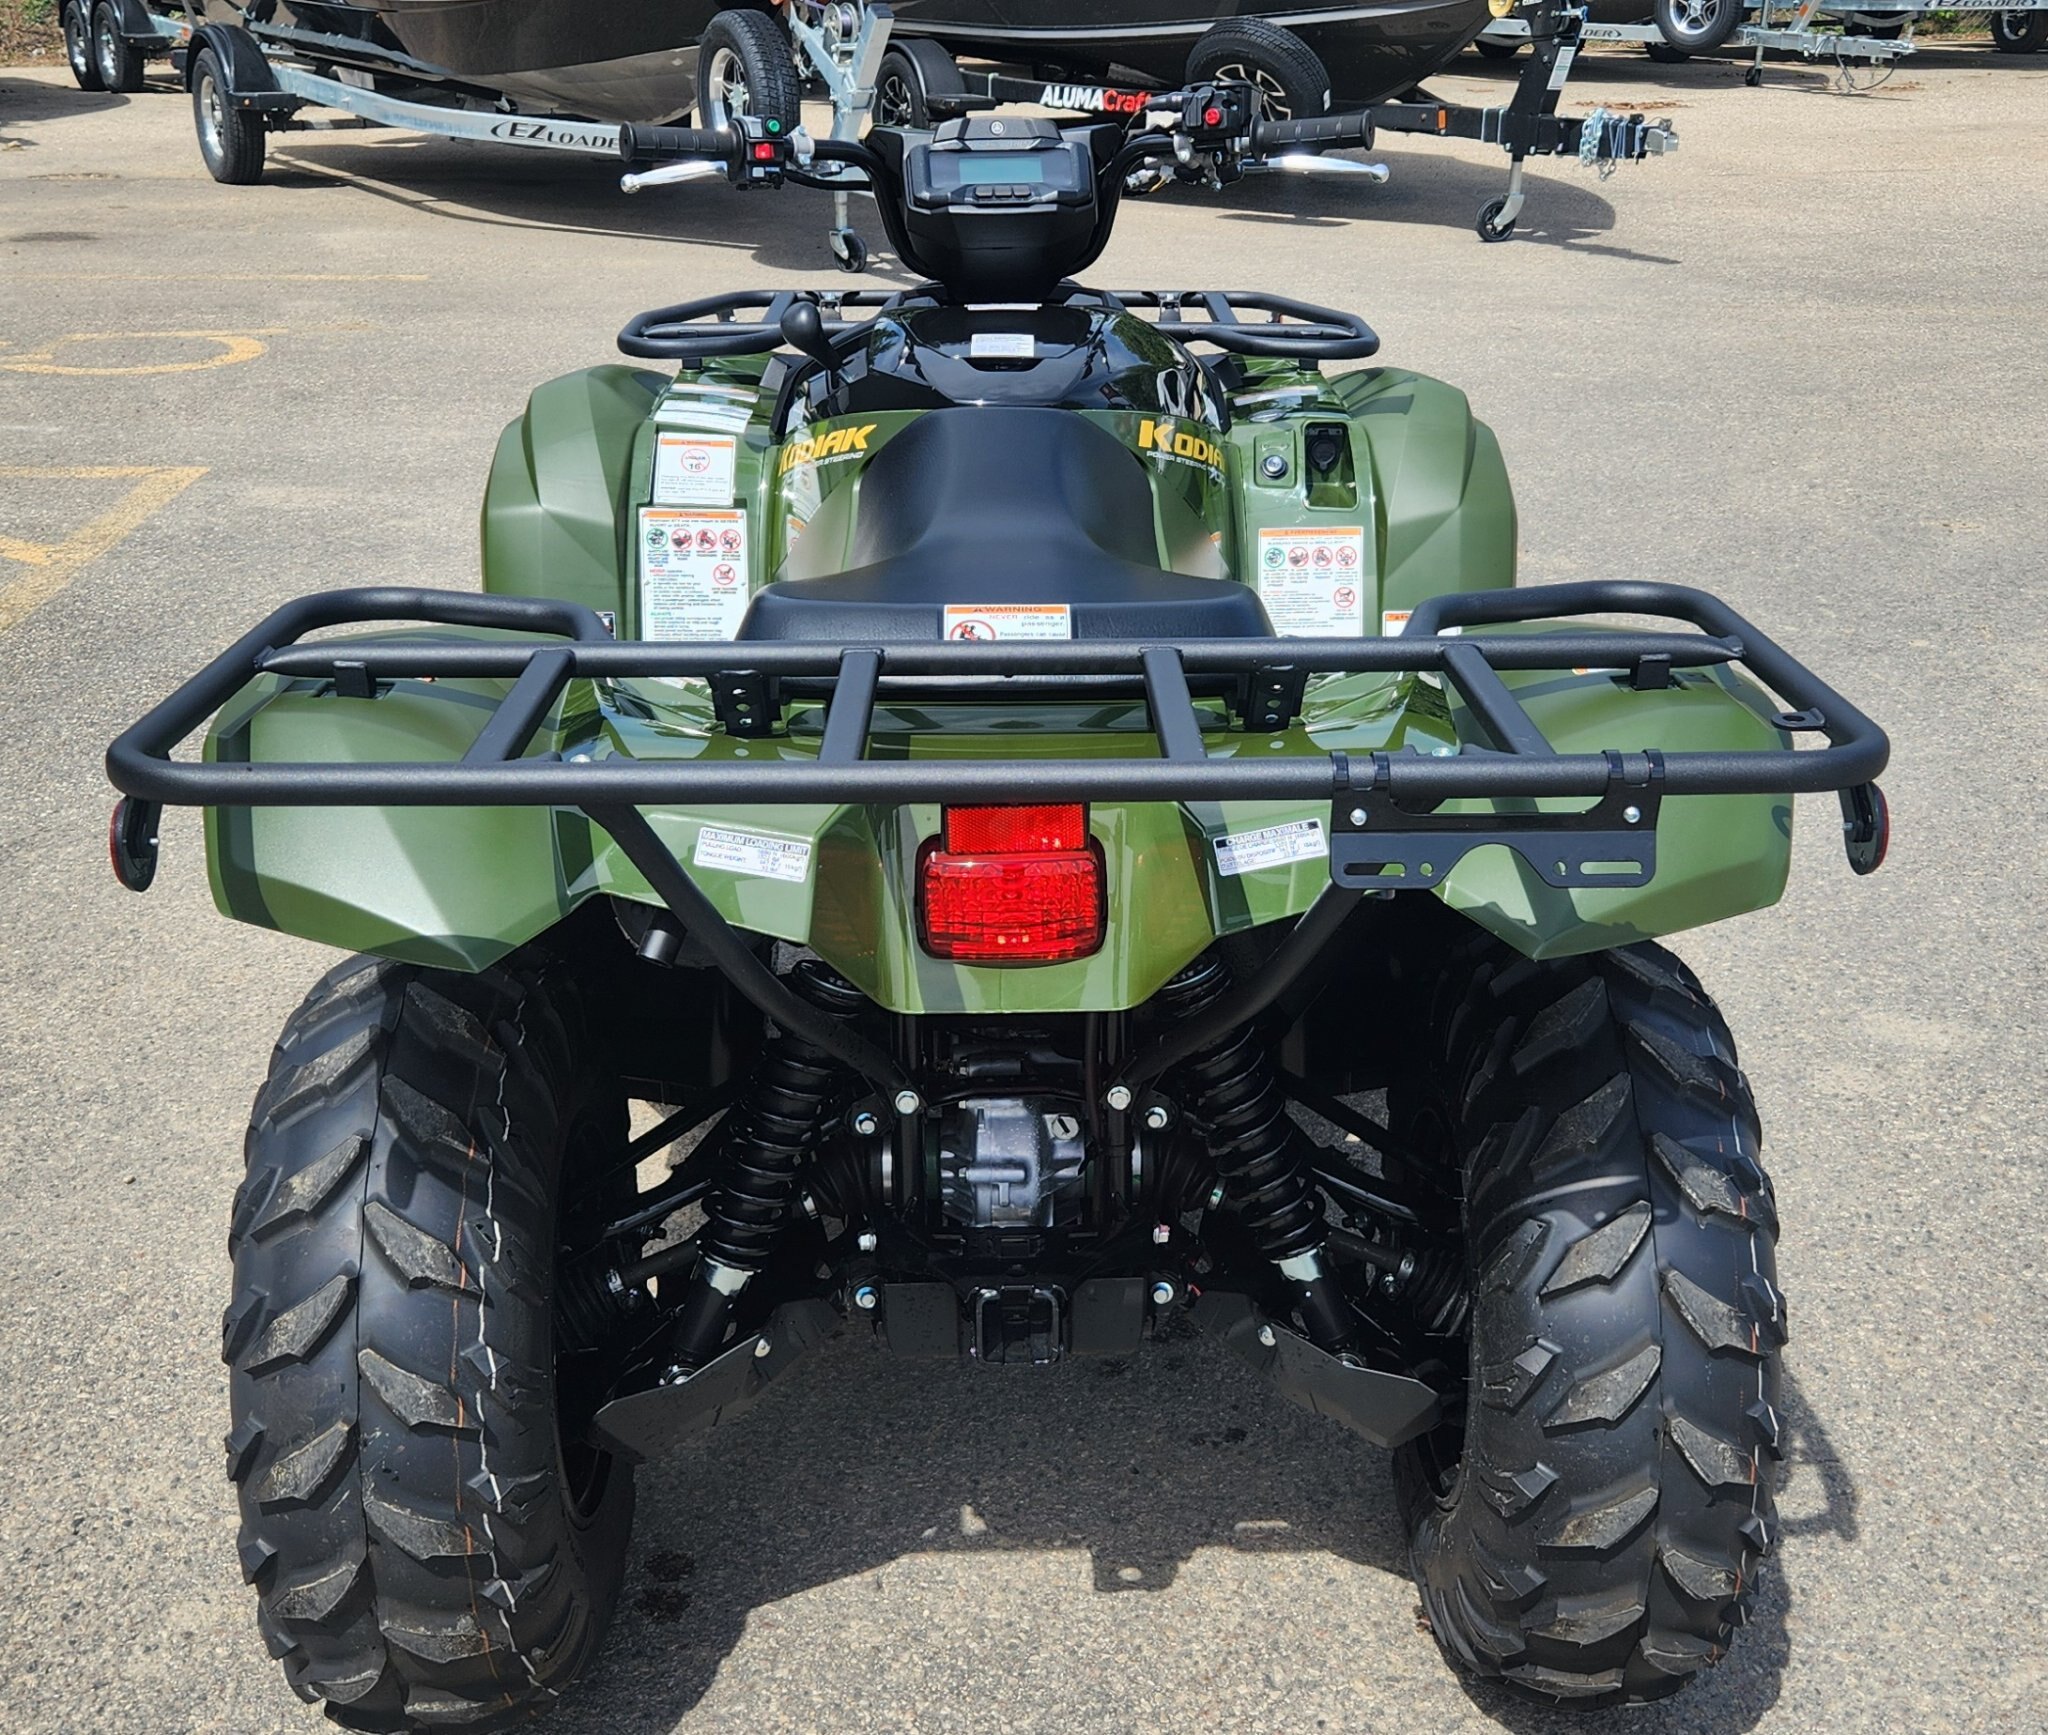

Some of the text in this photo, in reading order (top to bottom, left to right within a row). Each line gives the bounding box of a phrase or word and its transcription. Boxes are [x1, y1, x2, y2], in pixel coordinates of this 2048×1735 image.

[778, 424, 877, 477] KODIAK
[1138, 420, 1225, 473] KODIA
[1146, 450, 1175, 461] POWER
[702, 831, 809, 856] MAXIMUM LOADING LIMIT
[1226, 823, 1309, 846] CHARGE MAXIMALE
